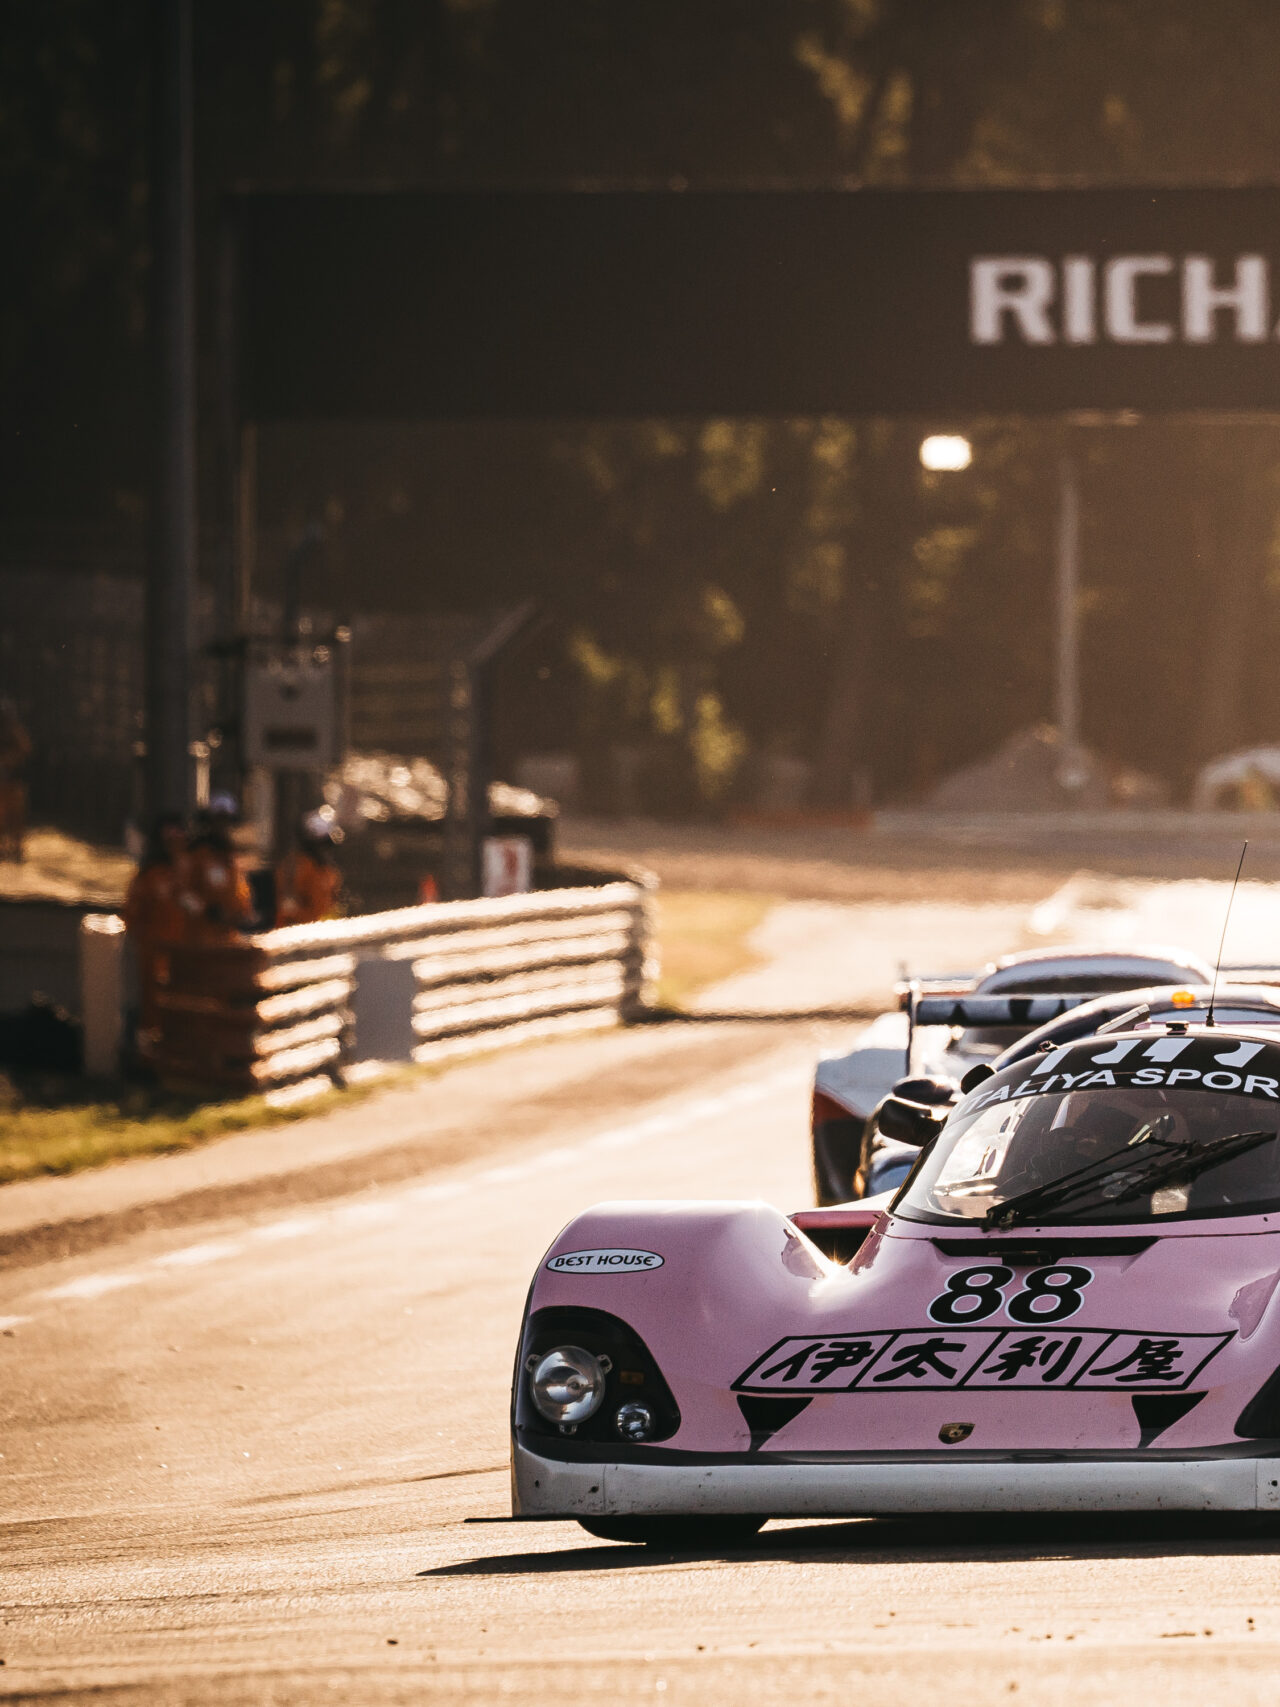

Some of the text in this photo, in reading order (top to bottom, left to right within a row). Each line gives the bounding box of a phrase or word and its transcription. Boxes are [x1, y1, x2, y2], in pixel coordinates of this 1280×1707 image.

[554, 1255, 656, 1268] BEST HOUSE
[927, 1265, 1094, 1326] 88
[759, 1335, 1185, 1384] 伊太利屋
